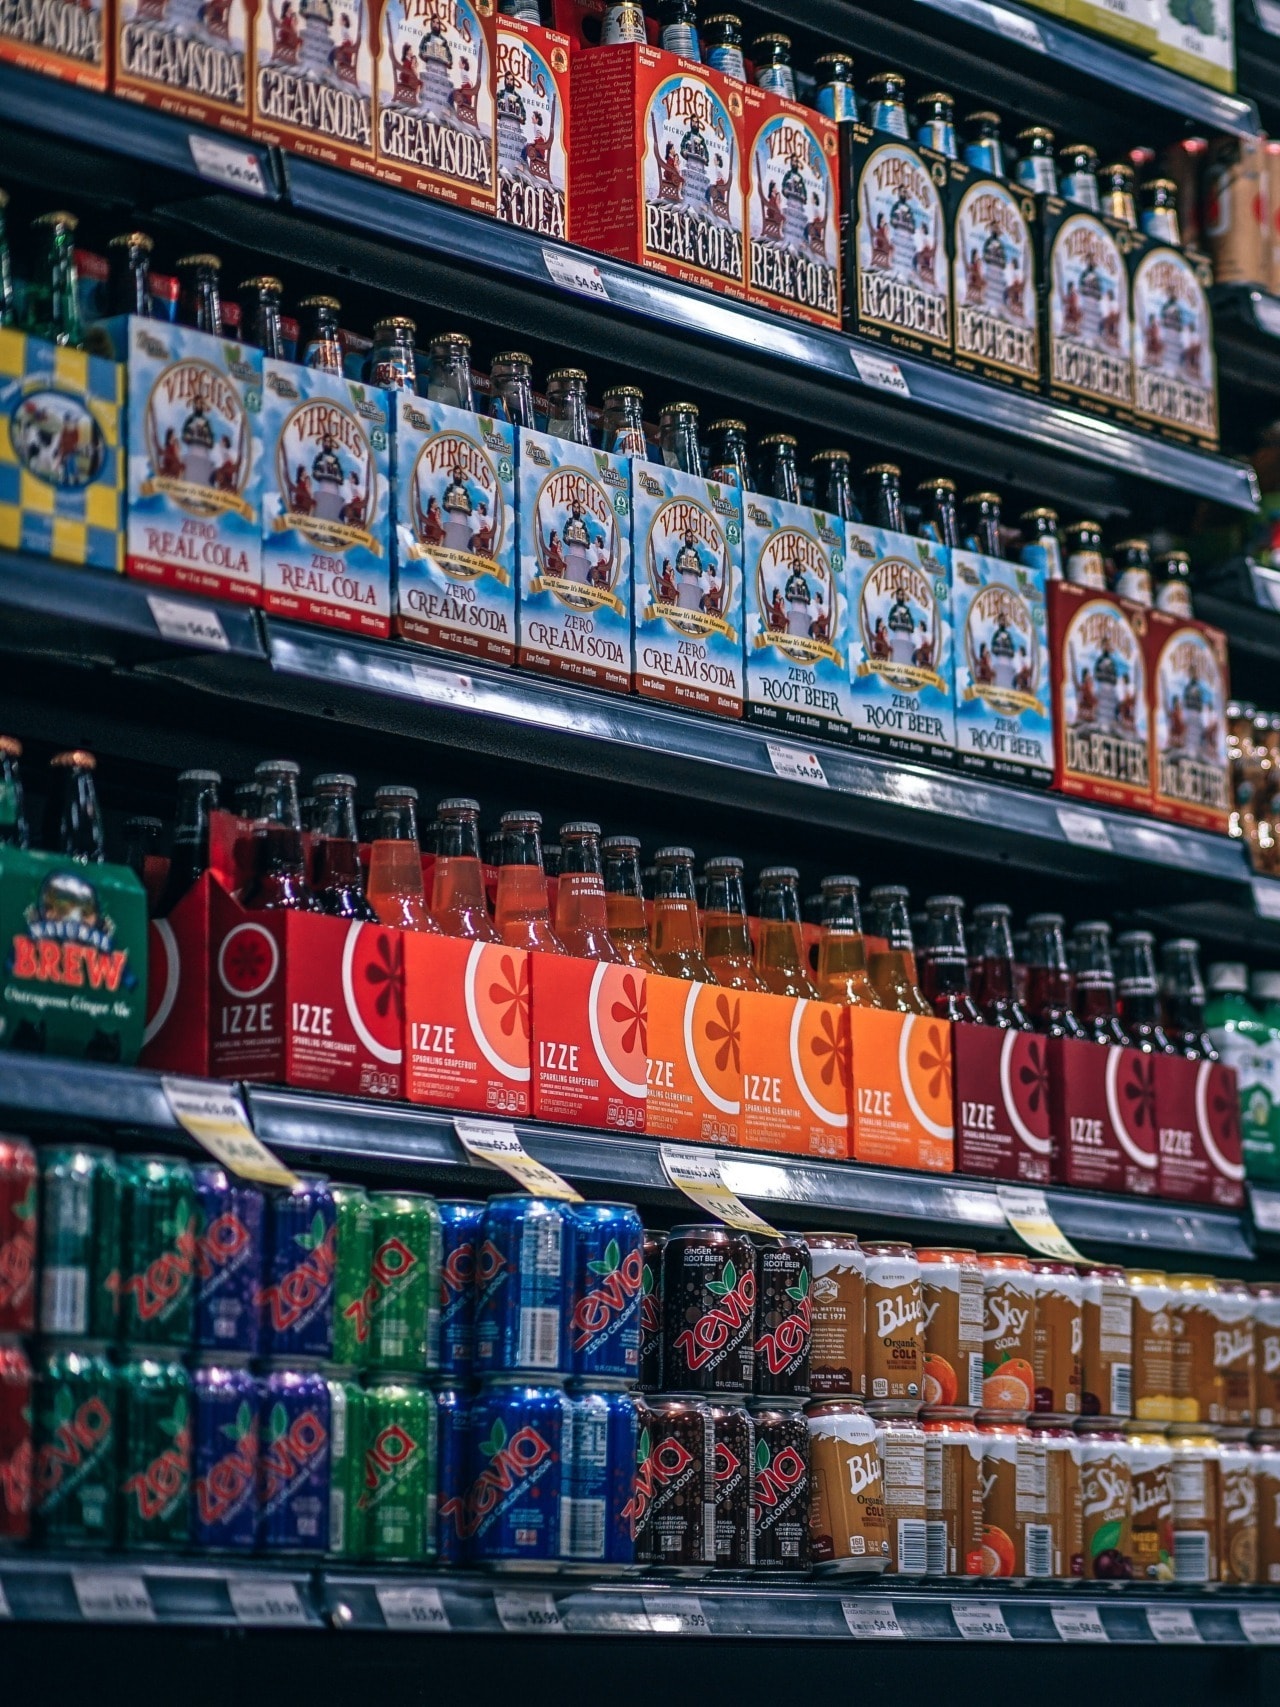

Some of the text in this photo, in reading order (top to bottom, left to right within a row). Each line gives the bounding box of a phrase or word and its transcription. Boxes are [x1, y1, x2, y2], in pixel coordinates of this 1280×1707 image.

[499, 17, 528, 32] Preservatives
[397, 25, 477, 55] MICRO BREWED
[684, 60, 709, 76] Preservatives
[662, 86, 725, 140] VIRGIL'S
[663, 124, 730, 153] MICRO BREWED
[765, 126, 821, 179] VIRGIL'S
[646, 204, 694, 261] REAL
[698, 222, 742, 278] COLA
[643, 258, 666, 272] Low Sodium
[750, 241, 794, 297] REAL
[797, 259, 837, 314] COLA
[575, 275, 603, 293] $4.99
[163, 366, 237, 422] VIRGIL'S
[293, 406, 363, 459] VIRGIL'S
[526, 441, 545, 458] Zero
[426, 439, 490, 490] VIRGIL'S
[639, 472, 658, 488] Zero
[547, 474, 607, 522] VIRGIL'S
[712, 496, 732, 510] Stevia
[181, 519, 217, 539] ZERO
[660, 504, 718, 551] VIRGIL'S
[143, 527, 249, 573] REAL COLA
[312, 553, 345, 575] ZERO
[769, 534, 825, 580] VIRGIL'S
[277, 562, 329, 595] REAL
[332, 576, 377, 605] COLA
[445, 583, 476, 603] ZERO
[872, 563, 928, 608] VIRGIL'S
[408, 589, 467, 623] CREAM
[469, 605, 508, 633] SODA
[565, 614, 593, 634] ZERO
[529, 622, 624, 664] CREAM SODA
[678, 640, 706, 660] ZERO
[526, 653, 550, 666] Low Sodium
[561, 661, 570, 670] Four
[643, 648, 736, 689] CREAM SODA
[642, 678, 665, 691] Low Sodium
[788, 667, 816, 685] ZERO
[675, 686, 684, 696] Four
[759, 676, 843, 716] ROOT BEER
[892, 694, 920, 712] ZERO
[863, 704, 947, 742] ROOT BEER
[969, 727, 1005, 752] ROOT
[1009, 736, 1046, 763] BEER
[796, 765, 824, 779] $4.99
[12, 934, 127, 991] BREW
[222, 1003, 273, 1034] IZZE
[292, 1003, 333, 1035] IZZE
[411, 1023, 455, 1054] IZZE
[412, 1054, 477, 1070] SPARKLING GRAPEFRUIT
[540, 1041, 578, 1071] IZZE
[540, 1072, 599, 1088] SPARKLING GRAPEFRUIT
[744, 1074, 781, 1103] IZZE
[665, 1092, 693, 1104] CLEMENTINE
[745, 1104, 801, 1117] SPARKLING CLEMENTINE
[858, 1087, 892, 1117] IZZE
[962, 1101, 996, 1131] IZZE
[1070, 1116, 1105, 1146] IZZE
[585, 1333, 609, 1355] ZERO
[704, 1321, 752, 1372] ZERO CALORIE
[884, 1337, 918, 1349] Organic
[892, 1349, 917, 1358] COLA
[994, 1336, 1021, 1350] SODA
[785, 1355, 803, 1376] ZERO
[672, 1468, 695, 1491] SODA
[722, 1473, 743, 1496] SODA
[847, 1452, 882, 1495] Blu
[760, 1477, 808, 1530] CALORIE SODA
[851, 1538, 863, 1546] 160
[874, 1620, 898, 1631] $4.69
